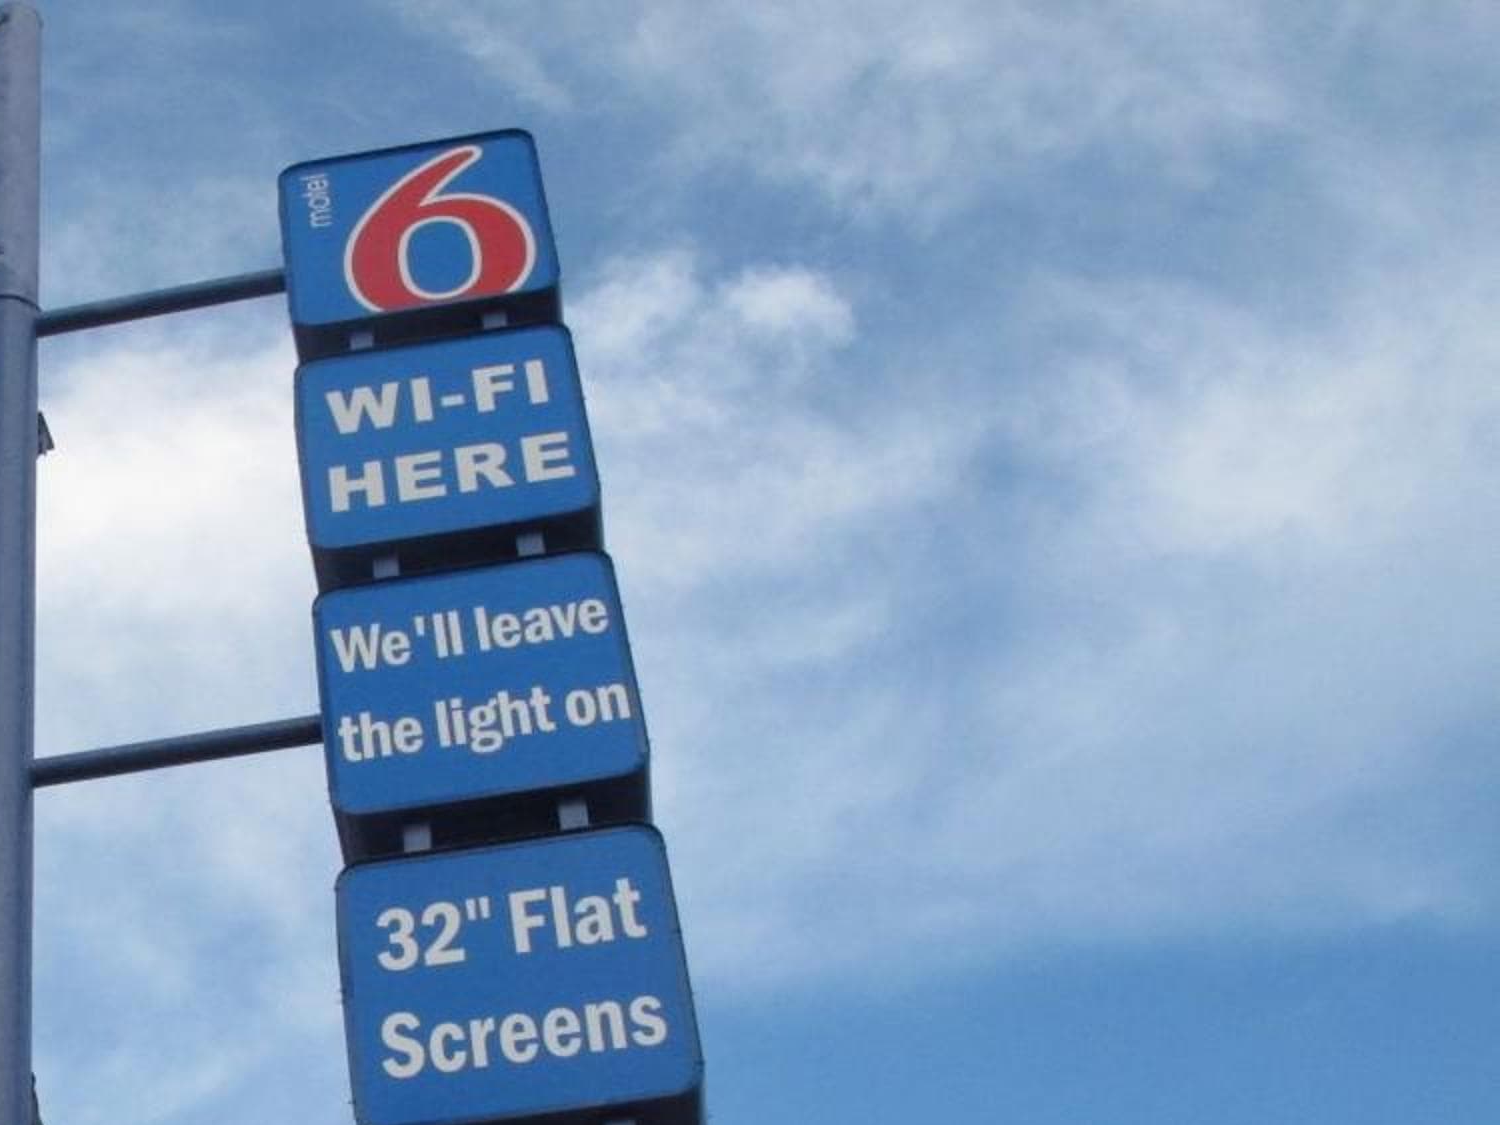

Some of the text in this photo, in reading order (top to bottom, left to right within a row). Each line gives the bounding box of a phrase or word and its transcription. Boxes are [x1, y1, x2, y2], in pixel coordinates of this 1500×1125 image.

[302, 174, 330, 228] motel
[344, 144, 536, 313] 6
[326, 359, 549, 435] WI-FI
[328, 431, 576, 513] HERE
[330, 598, 609, 673] We'll leave
[338, 681, 631, 763] the light on
[376, 877, 648, 972] 32" Flat
[381, 995, 668, 1079] Screens
